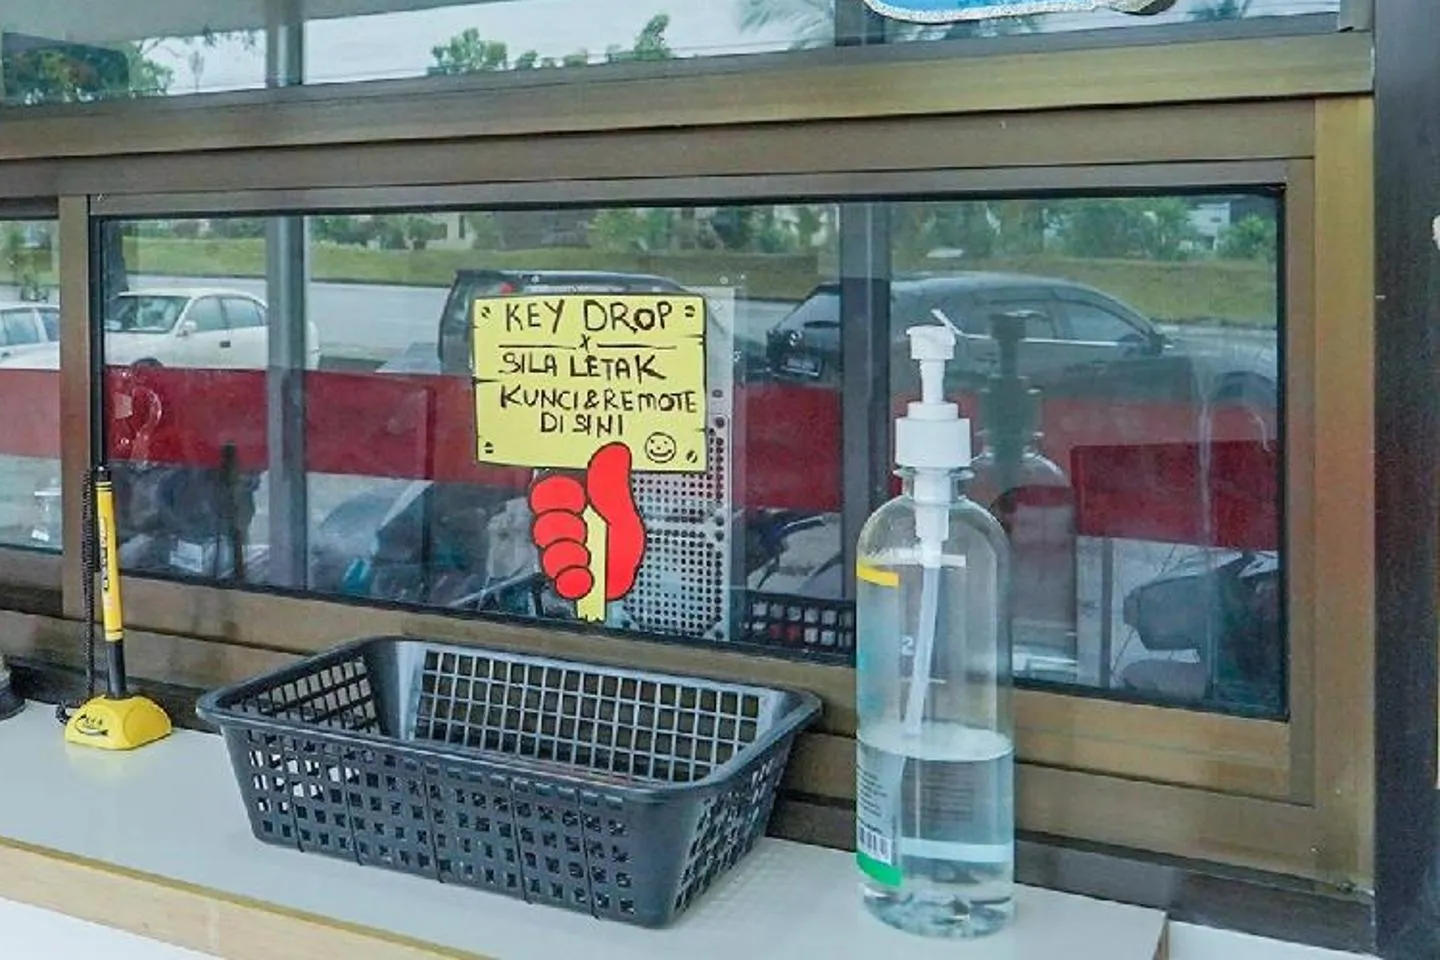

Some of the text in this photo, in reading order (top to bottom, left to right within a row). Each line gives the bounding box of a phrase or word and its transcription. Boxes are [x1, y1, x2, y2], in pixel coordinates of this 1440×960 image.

[505, 299, 673, 333] KEY DROP
[498, 352, 667, 383] SILA LETAK
[540, 413, 624, 438] DI SINI
